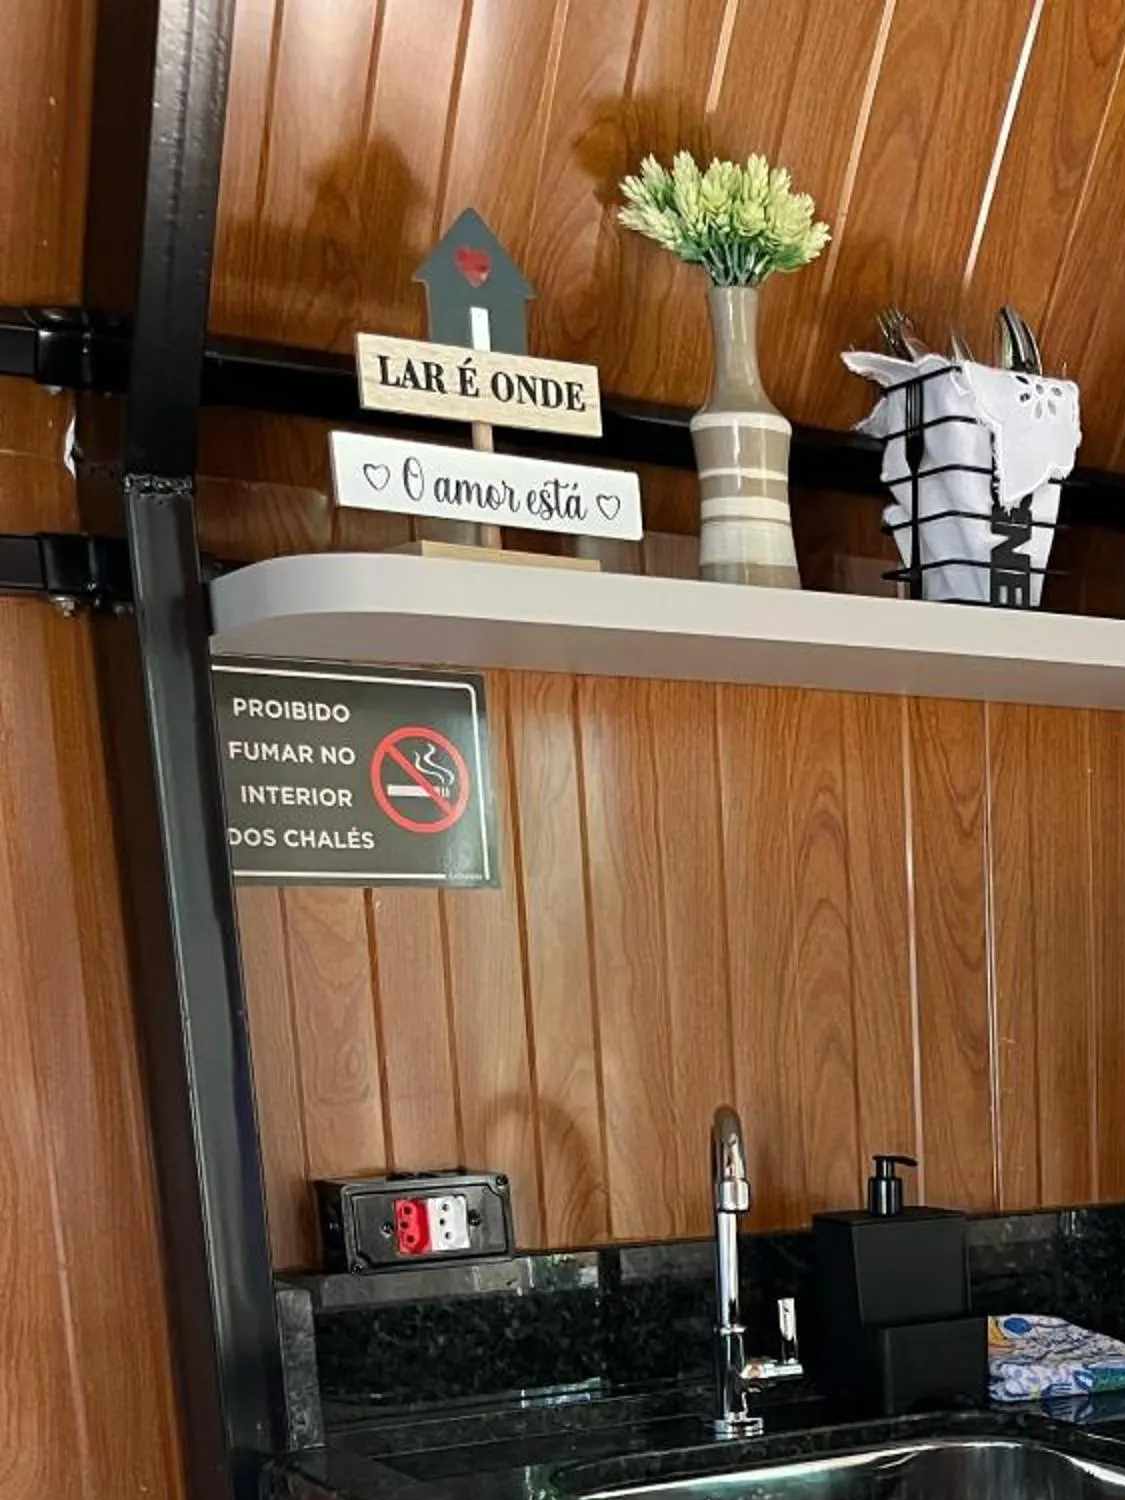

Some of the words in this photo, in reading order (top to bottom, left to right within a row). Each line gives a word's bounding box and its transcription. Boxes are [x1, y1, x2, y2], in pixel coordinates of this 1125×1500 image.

[377, 355, 446, 394] LAR
[458, 358, 479, 398] É
[491, 371, 586, 412] ONDE
[403, 456, 424, 501] O
[433, 475, 520, 514] amor
[526, 481, 587, 521] está
[233, 697, 350, 723] PROIBIDO
[228, 741, 313, 763] FUMAR
[321, 746, 356, 765] NO
[240, 785, 353, 808] INTERIOR
[228, 828, 276, 847] DOS
[283, 827, 375, 849] CHALÉS
